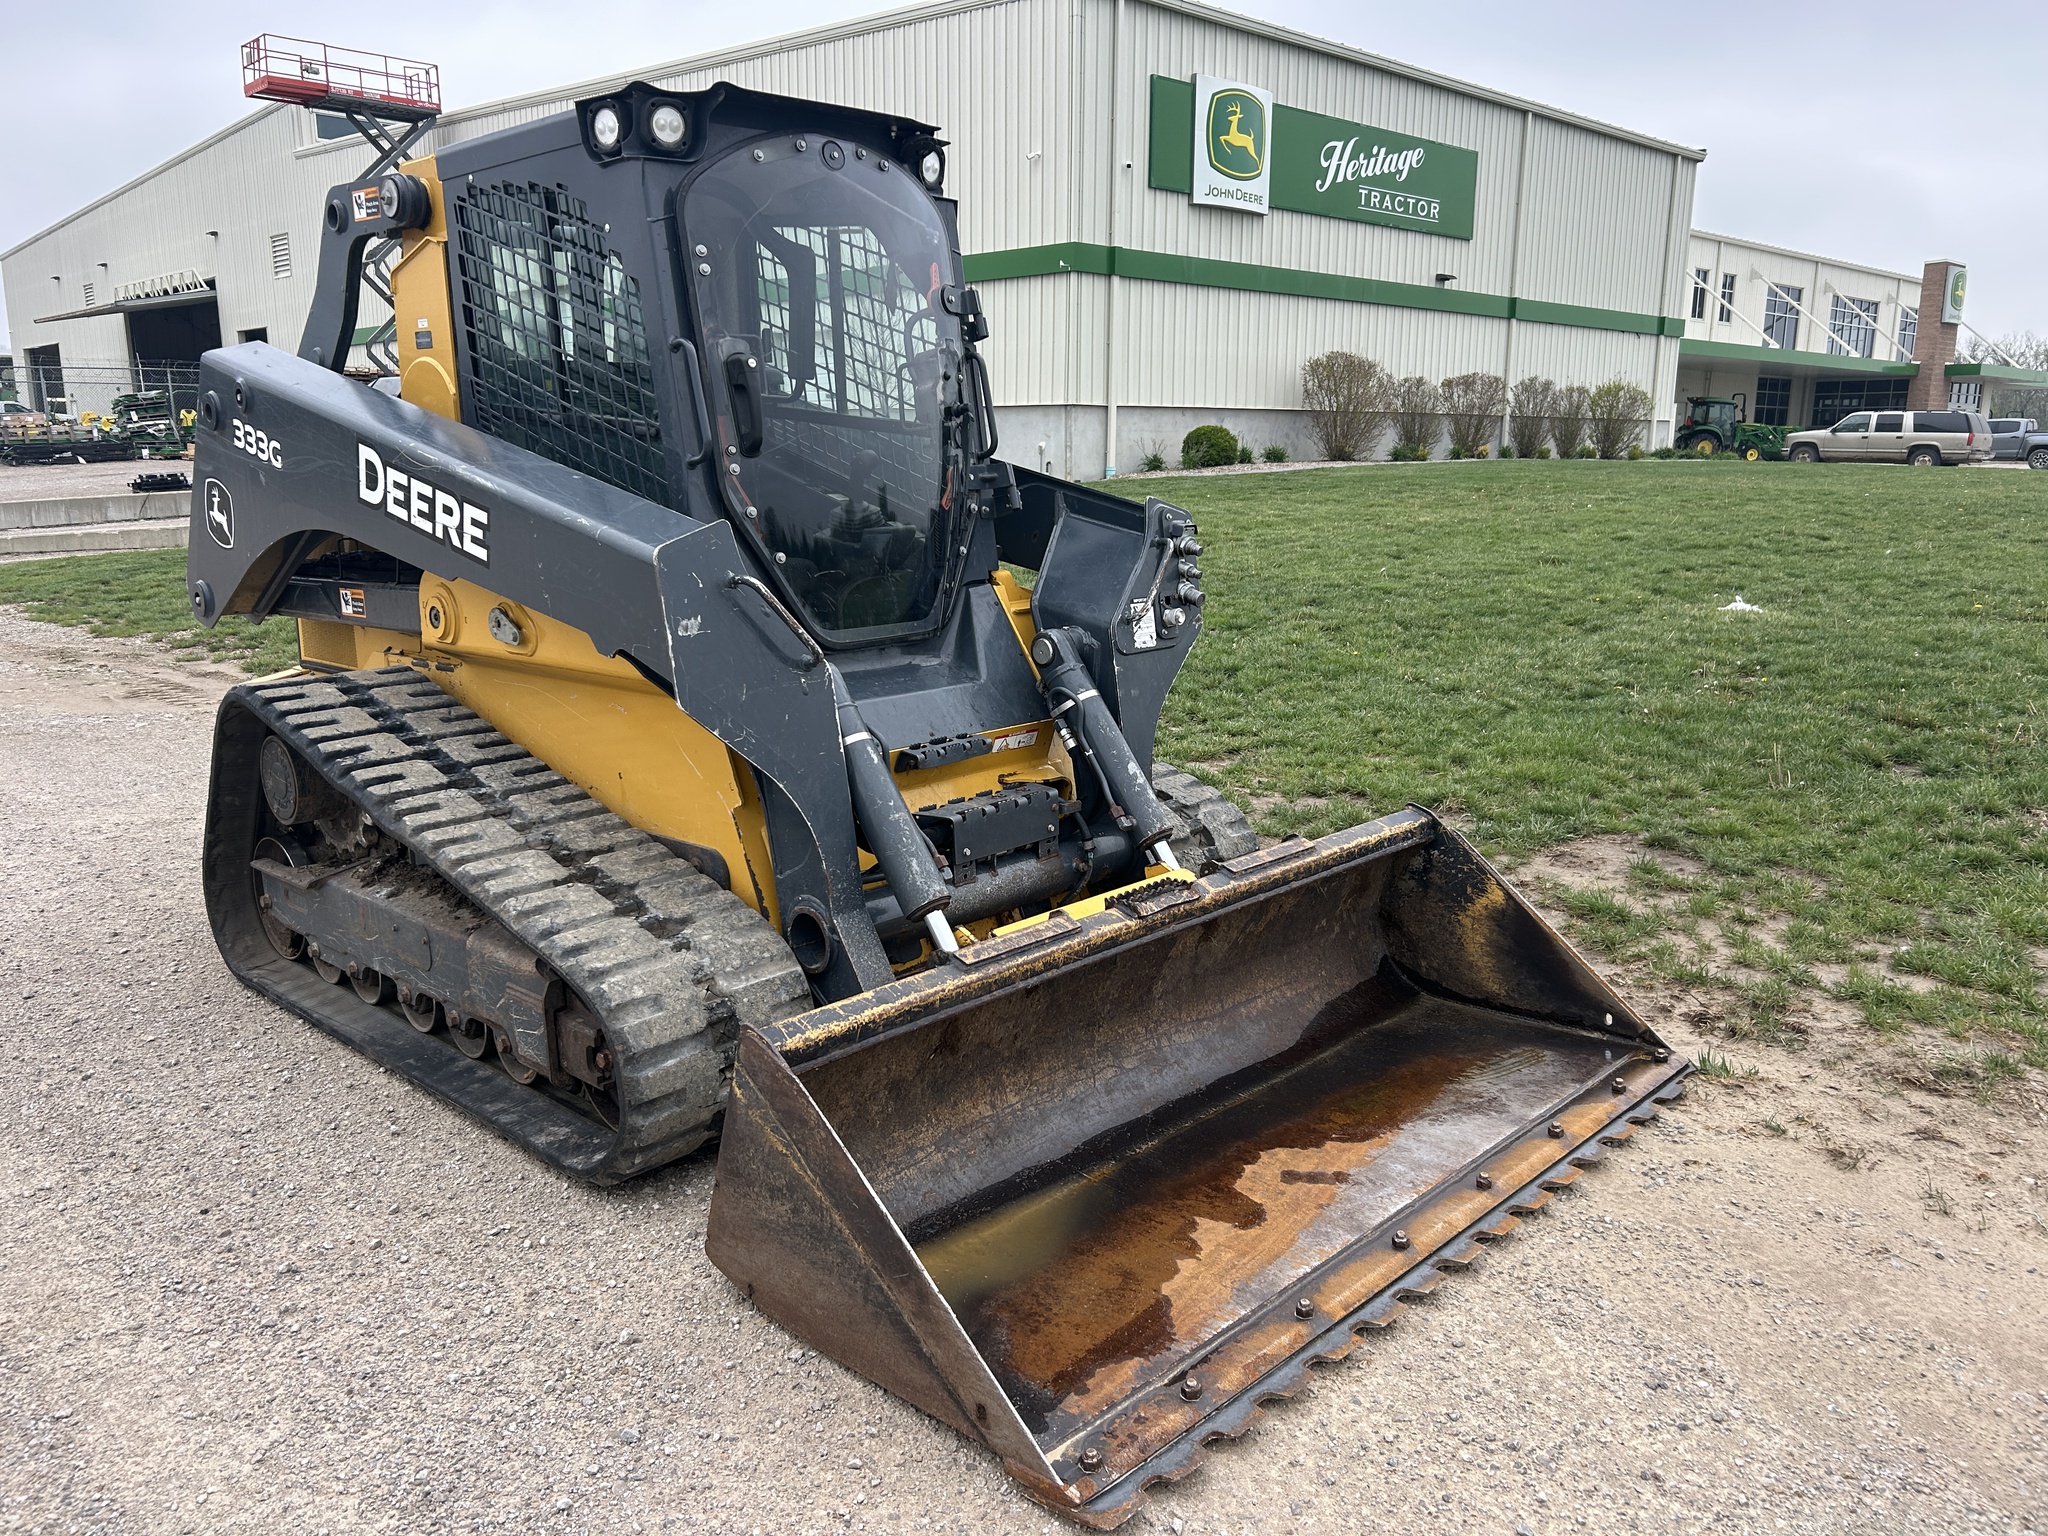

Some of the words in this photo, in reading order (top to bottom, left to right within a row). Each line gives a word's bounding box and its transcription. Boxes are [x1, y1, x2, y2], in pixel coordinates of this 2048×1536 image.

[1315, 137, 1425, 192] Heritage
[1204, 184, 1234, 199] JOHN
[1235, 188, 1263, 205] DEERE
[1359, 189, 1440, 219] TRACTOR
[232, 418, 283, 469] 333G
[358, 442, 488, 562] DEERE
